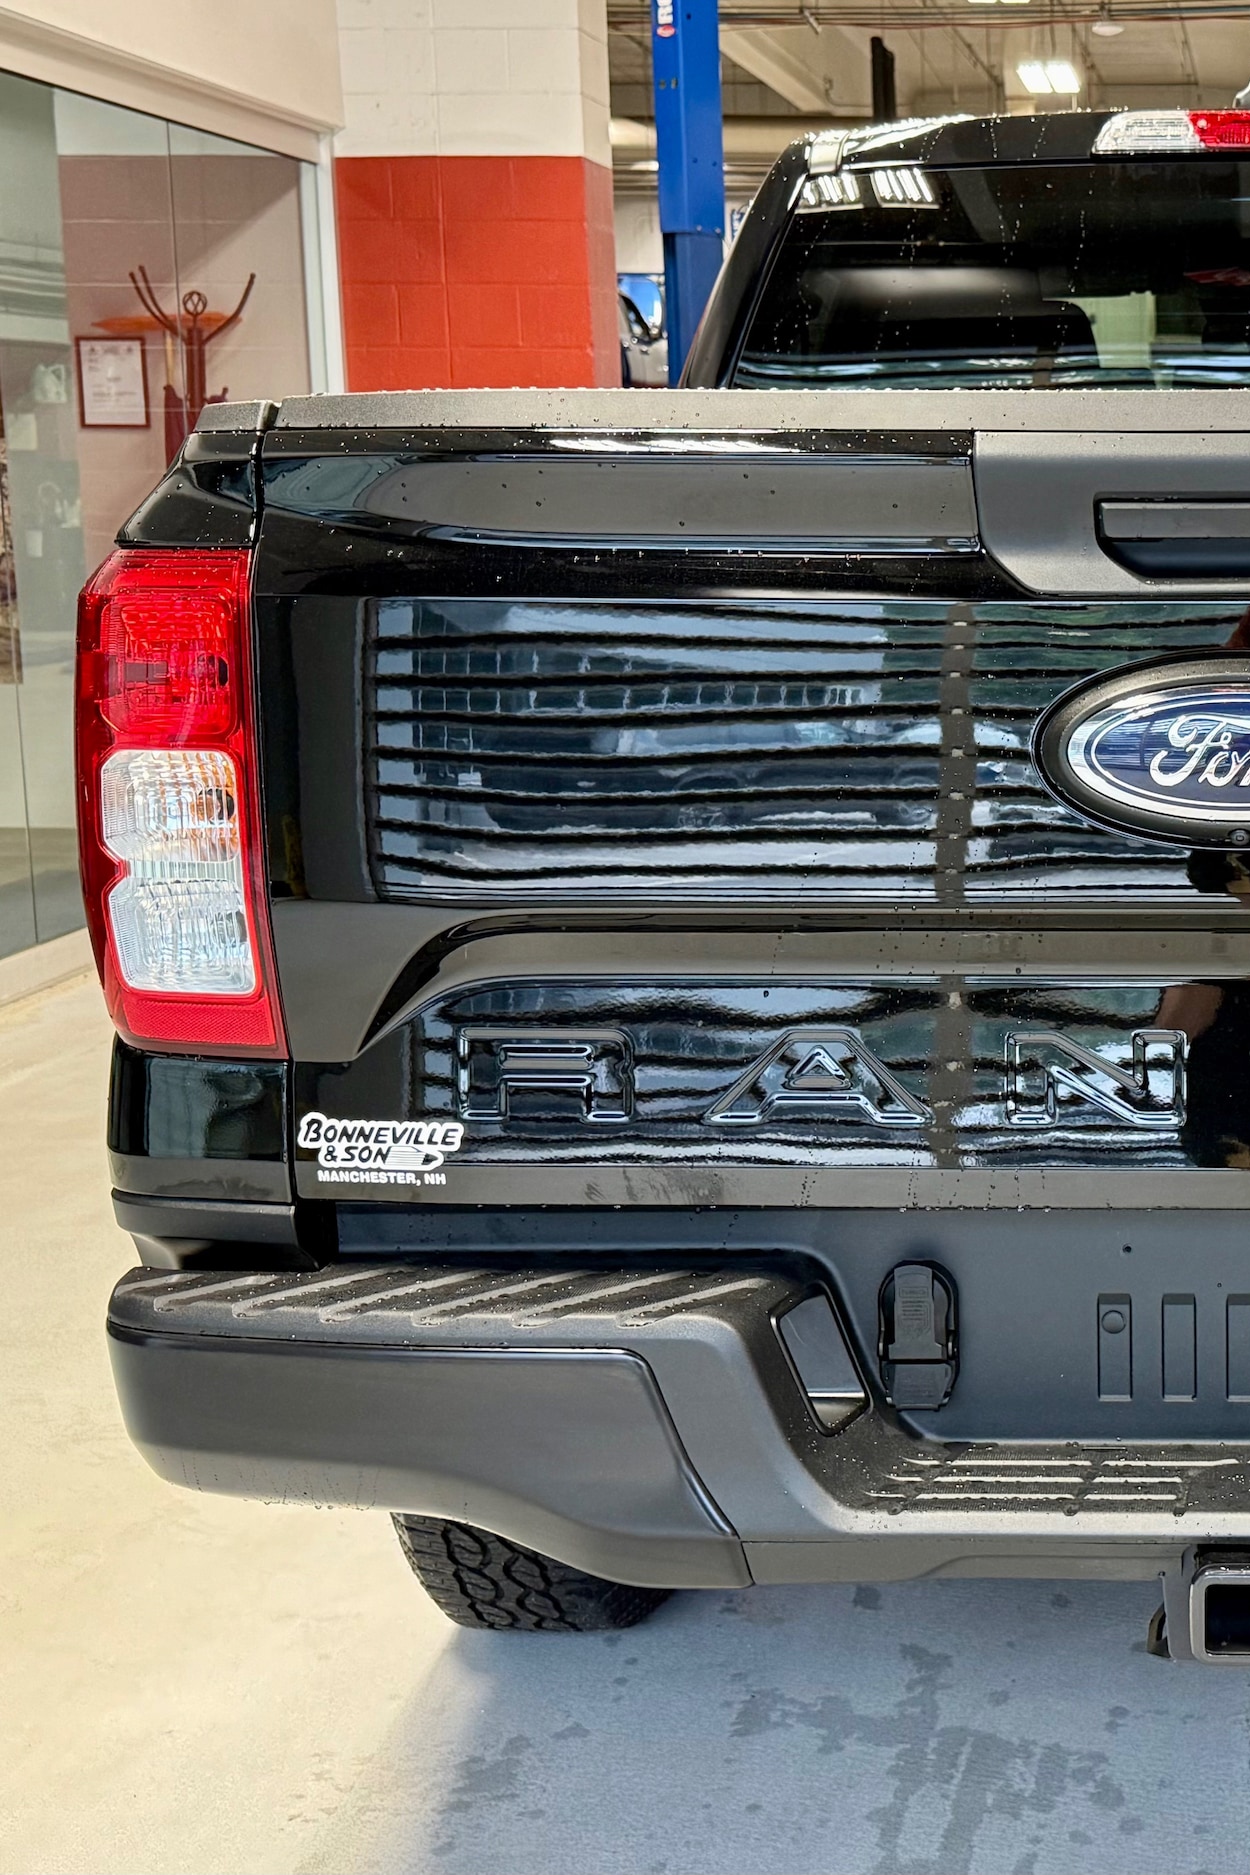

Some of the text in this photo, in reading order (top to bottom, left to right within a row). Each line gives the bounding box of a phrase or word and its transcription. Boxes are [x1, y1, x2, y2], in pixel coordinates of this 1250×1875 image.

[303, 1118, 459, 1146] BONNEVILLE
[323, 1145, 391, 1164] & SON
[317, 1170, 447, 1187] MANCHESTER, NH
